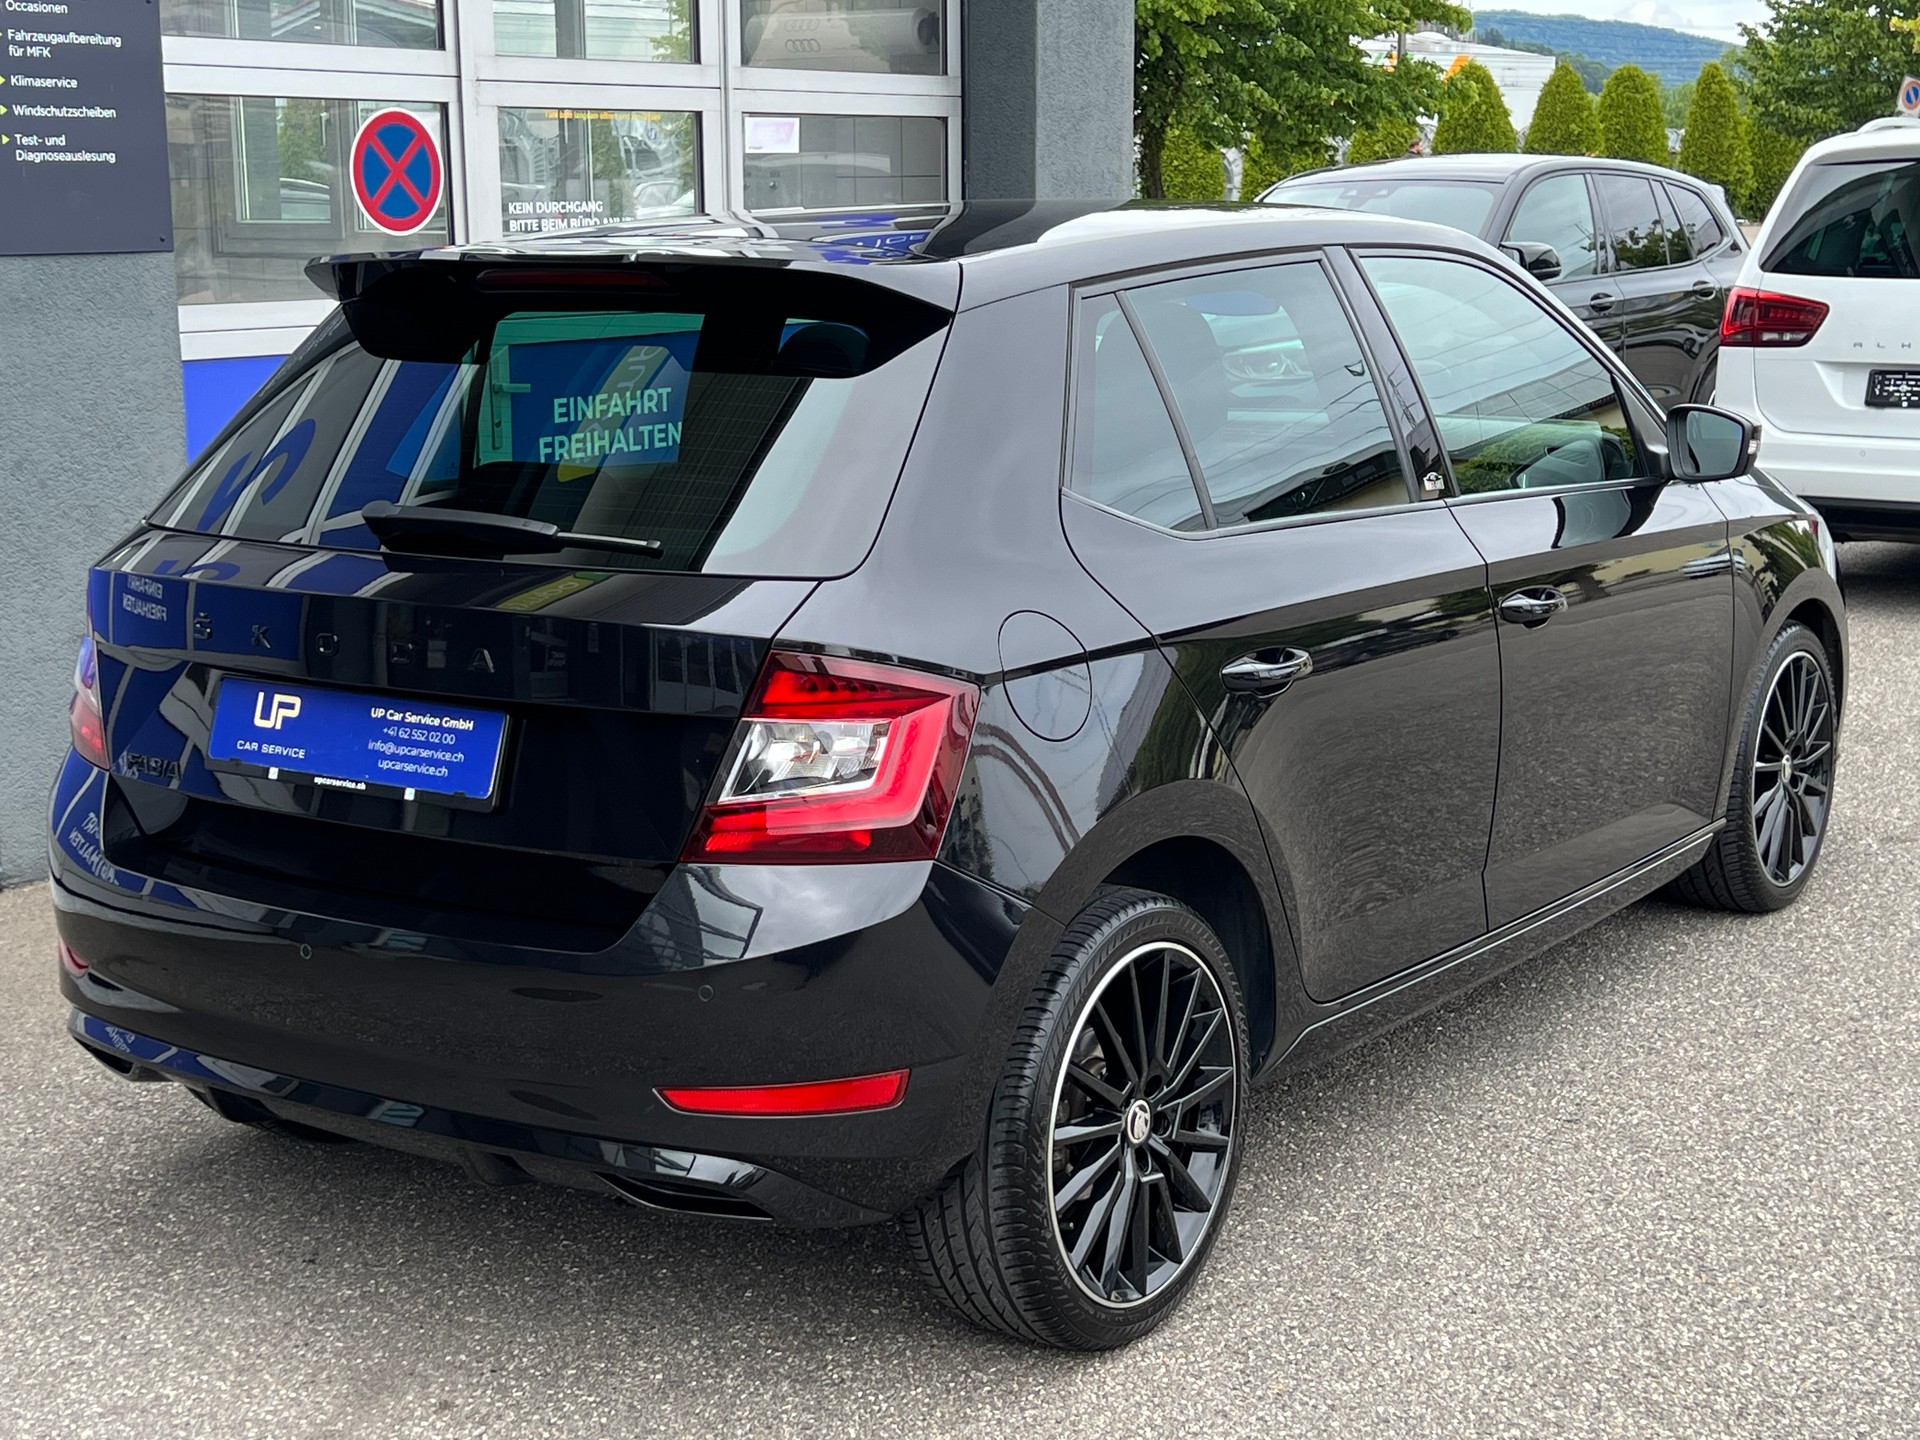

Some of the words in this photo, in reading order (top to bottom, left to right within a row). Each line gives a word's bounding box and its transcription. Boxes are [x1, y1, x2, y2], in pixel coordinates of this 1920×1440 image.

[5, 0, 68, 14] Occasionen
[7, 29, 122, 48] Fahrzeugaufbereitung
[8, 45, 25, 57] für
[26, 47, 51, 58] MFK
[10, 75, 78, 88] Klimaservice
[12, 104, 117, 119] Windschutzscheiben
[14, 134, 43, 145] Test-
[44, 134, 66, 146] und
[15, 150, 117, 164] Diagnoseauslesung
[508, 201, 534, 214] KEIN
[535, 201, 603, 214] DURCHGANG
[509, 218, 539, 232] BITTE
[541, 217, 568, 232] BEIM
[553, 387, 672, 424] EINFAHRT
[539, 421, 683, 464] FREIHALTEN
[254, 692, 301, 729] UP
[370, 707, 386, 719] UP
[386, 708, 404, 721] Car
[404, 711, 441, 727] Service
[441, 715, 475, 731] GmbH
[382, 725, 398, 738] +41
[398, 728, 411, 740] 62
[410, 729, 429, 742] 552
[429, 731, 442, 744] 02
[442, 733, 456, 745] 00
[236, 740, 259, 752] CAR
[261, 742, 306, 759] SERVICE
[368, 740, 464, 762] info@upcarservice.ch
[127, 752, 181, 778] FABIA
[378, 758, 448, 776] upcarservice.ch
[314, 777, 365, 790] upcarservice.ch
